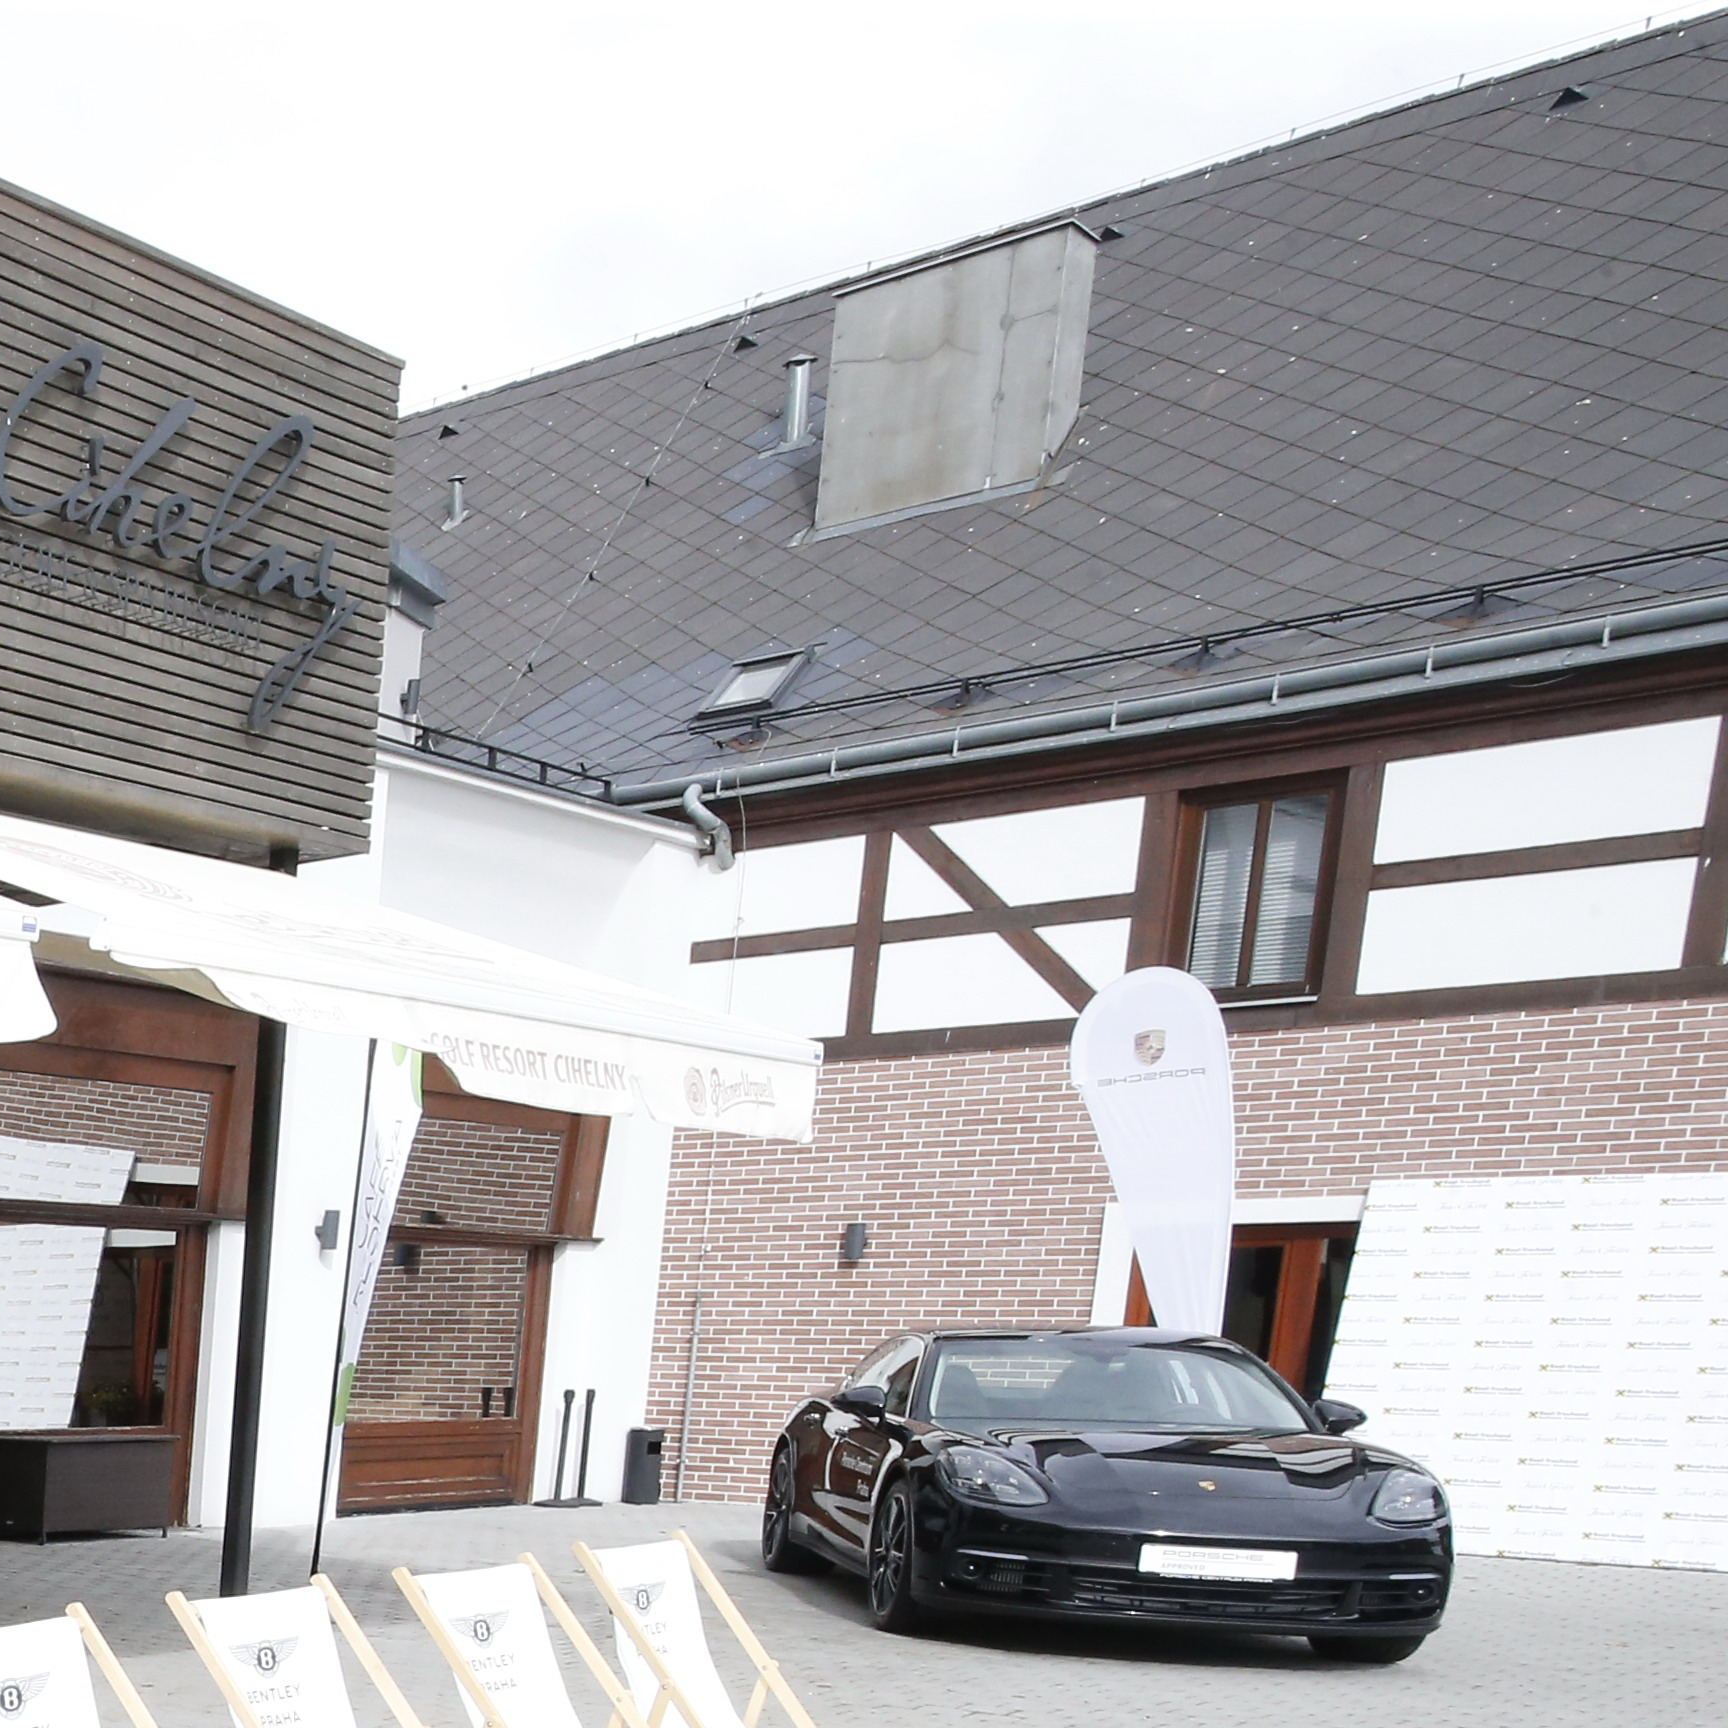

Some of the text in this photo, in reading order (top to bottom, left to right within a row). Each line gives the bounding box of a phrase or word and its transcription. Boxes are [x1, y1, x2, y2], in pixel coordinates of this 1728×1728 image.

[480, 1042, 547, 1080] RESORT
[554, 1054, 627, 1091] CIHELNY
[1163, 1550, 1264, 1561] PORSCHE
[1161, 1563, 1205, 1571] APPROVED
[247, 1683, 300, 1704] BENTLEY
[260, 1711, 301, 1727] PRAHA
